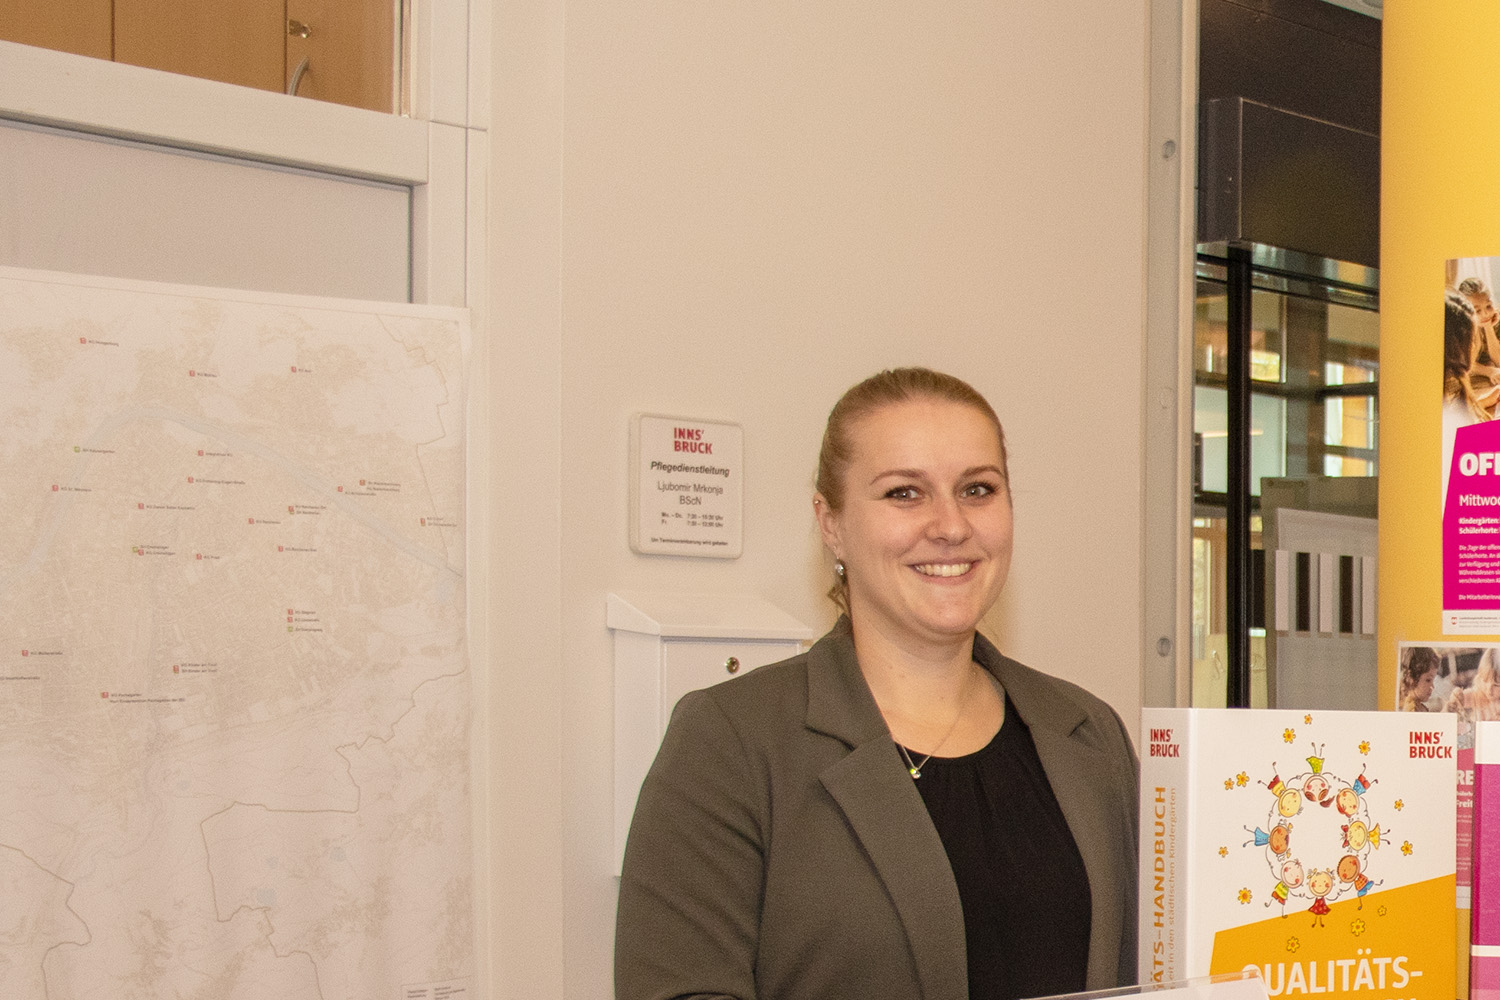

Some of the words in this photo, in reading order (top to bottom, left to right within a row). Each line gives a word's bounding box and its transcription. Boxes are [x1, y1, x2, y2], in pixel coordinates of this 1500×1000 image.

[673, 427, 705, 441] INNS'
[674, 440, 713, 454] BRUCK
[650, 461, 730, 478] Pflegedienstleitung
[657, 480, 691, 493] Ljubomir
[1150, 728, 1173, 743] INNS'
[1409, 731, 1444, 745] INNS'
[1150, 742, 1180, 758] BRUCK
[1409, 745, 1452, 759] BRUCK
